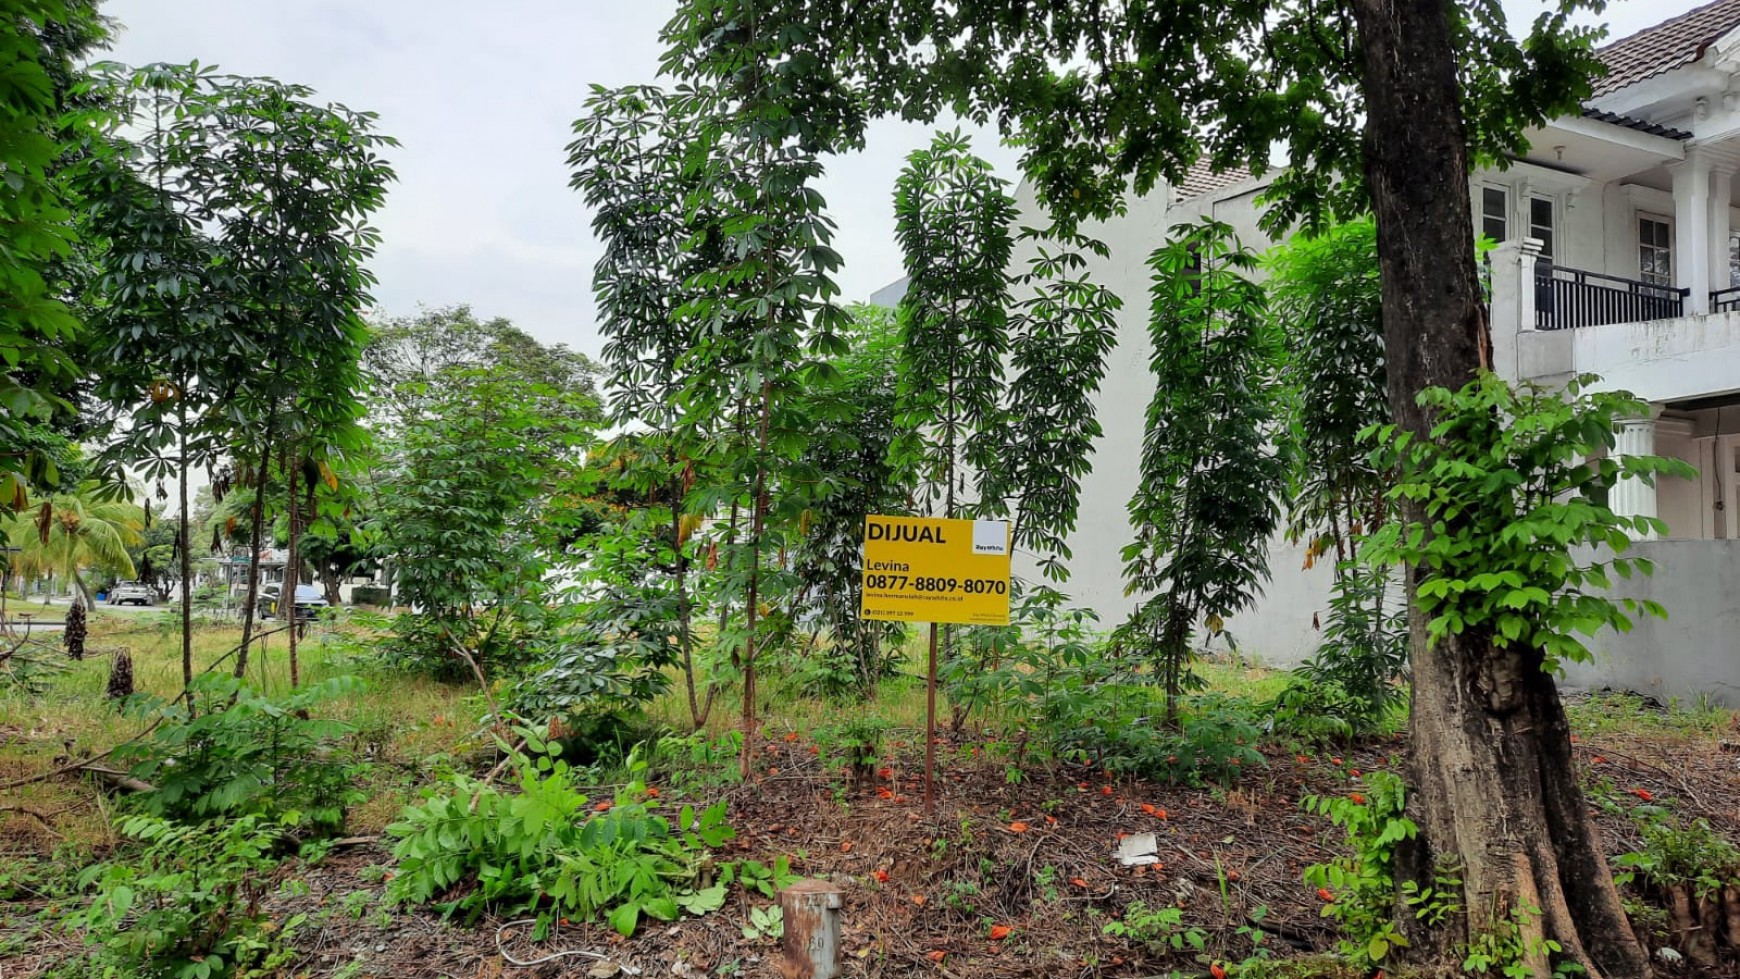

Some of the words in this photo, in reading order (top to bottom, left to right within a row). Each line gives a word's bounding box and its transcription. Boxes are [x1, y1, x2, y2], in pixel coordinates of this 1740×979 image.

[868, 523, 946, 544] DIJUAL
[867, 559, 910, 572] Levina
[866, 574, 1006, 594] 0877-8809-8070
